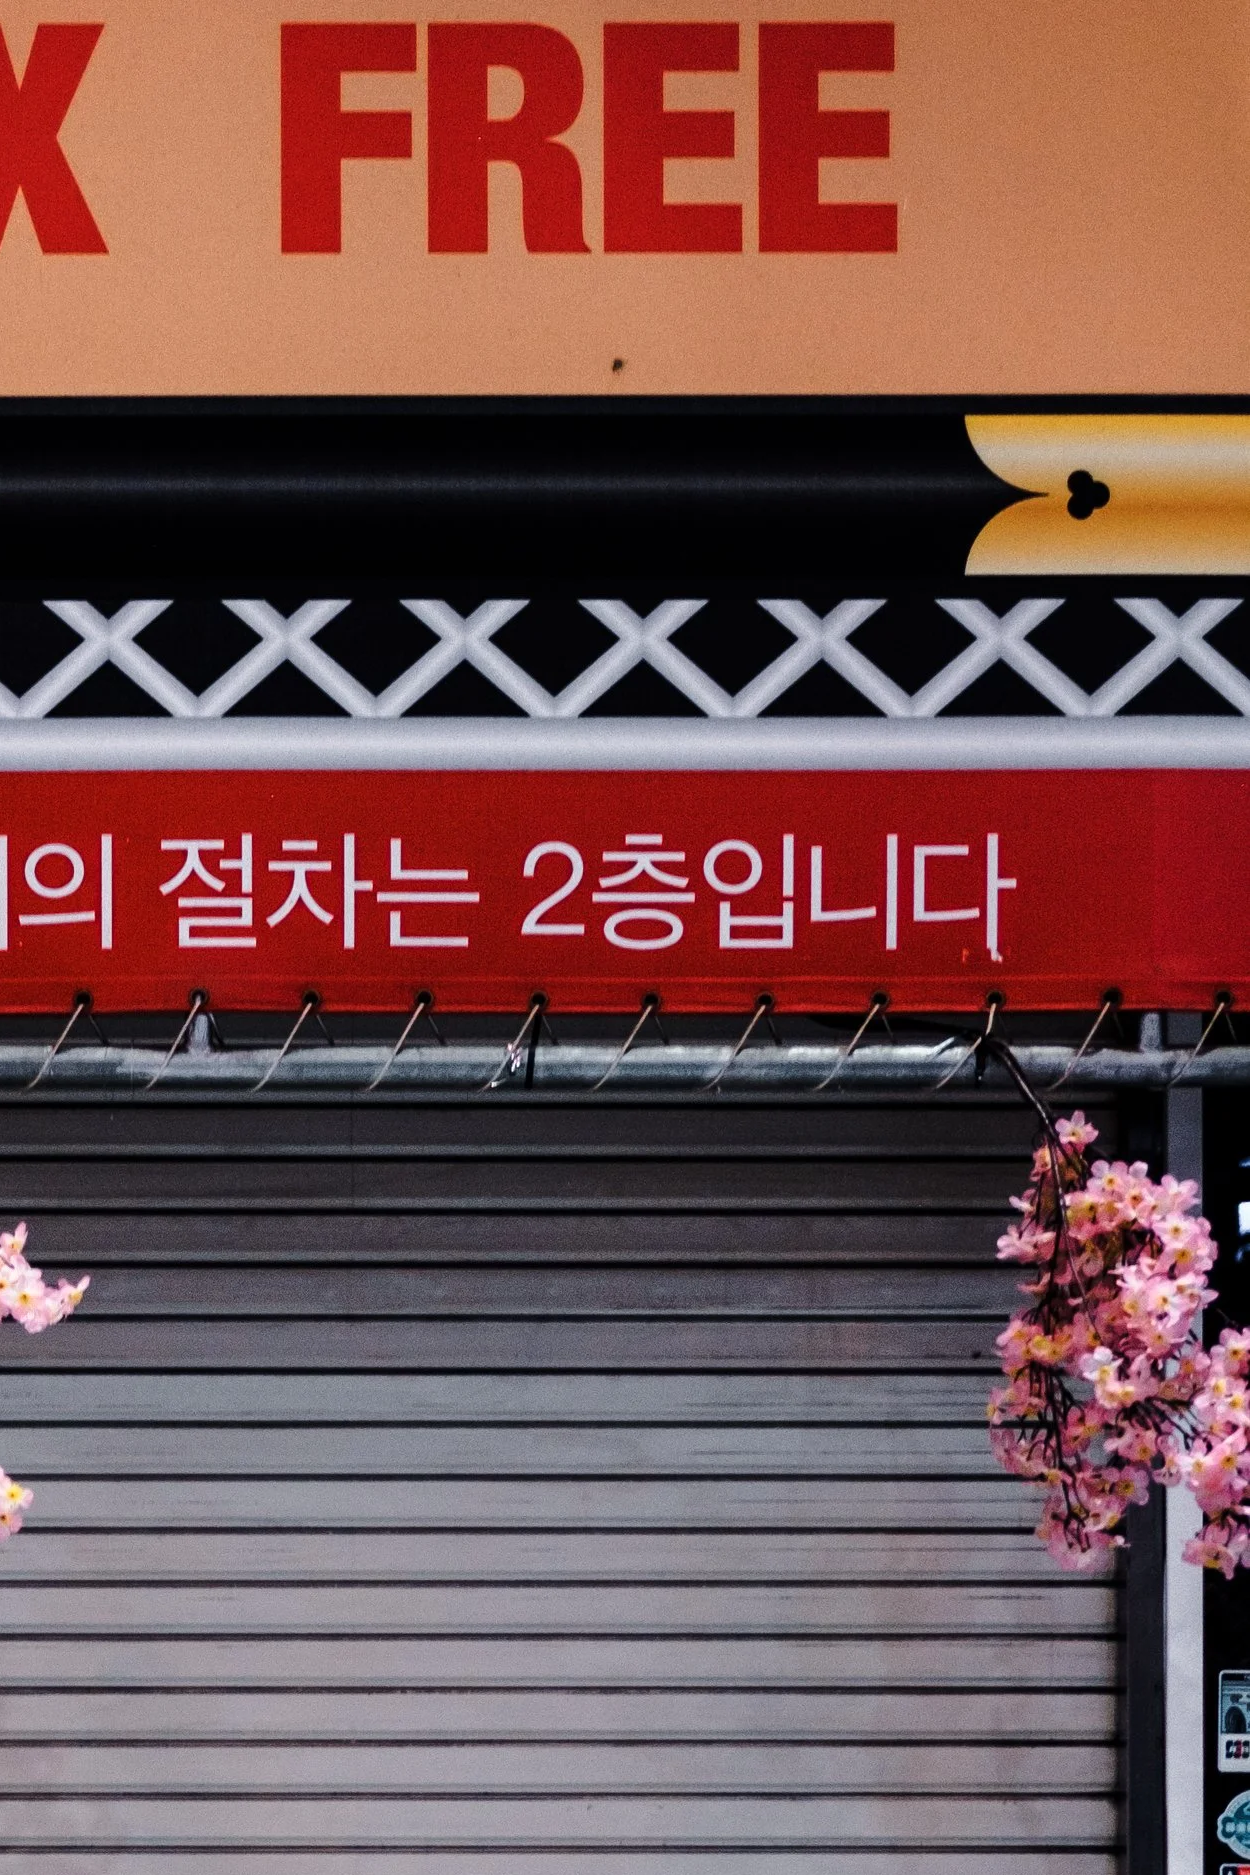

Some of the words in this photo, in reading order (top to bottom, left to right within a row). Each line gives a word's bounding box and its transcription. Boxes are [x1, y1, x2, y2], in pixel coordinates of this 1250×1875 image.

[280, 20, 900, 256] FREE
[159, 833, 480, 951] 절차는
[521, 833, 1018, 958] 2층입니다
